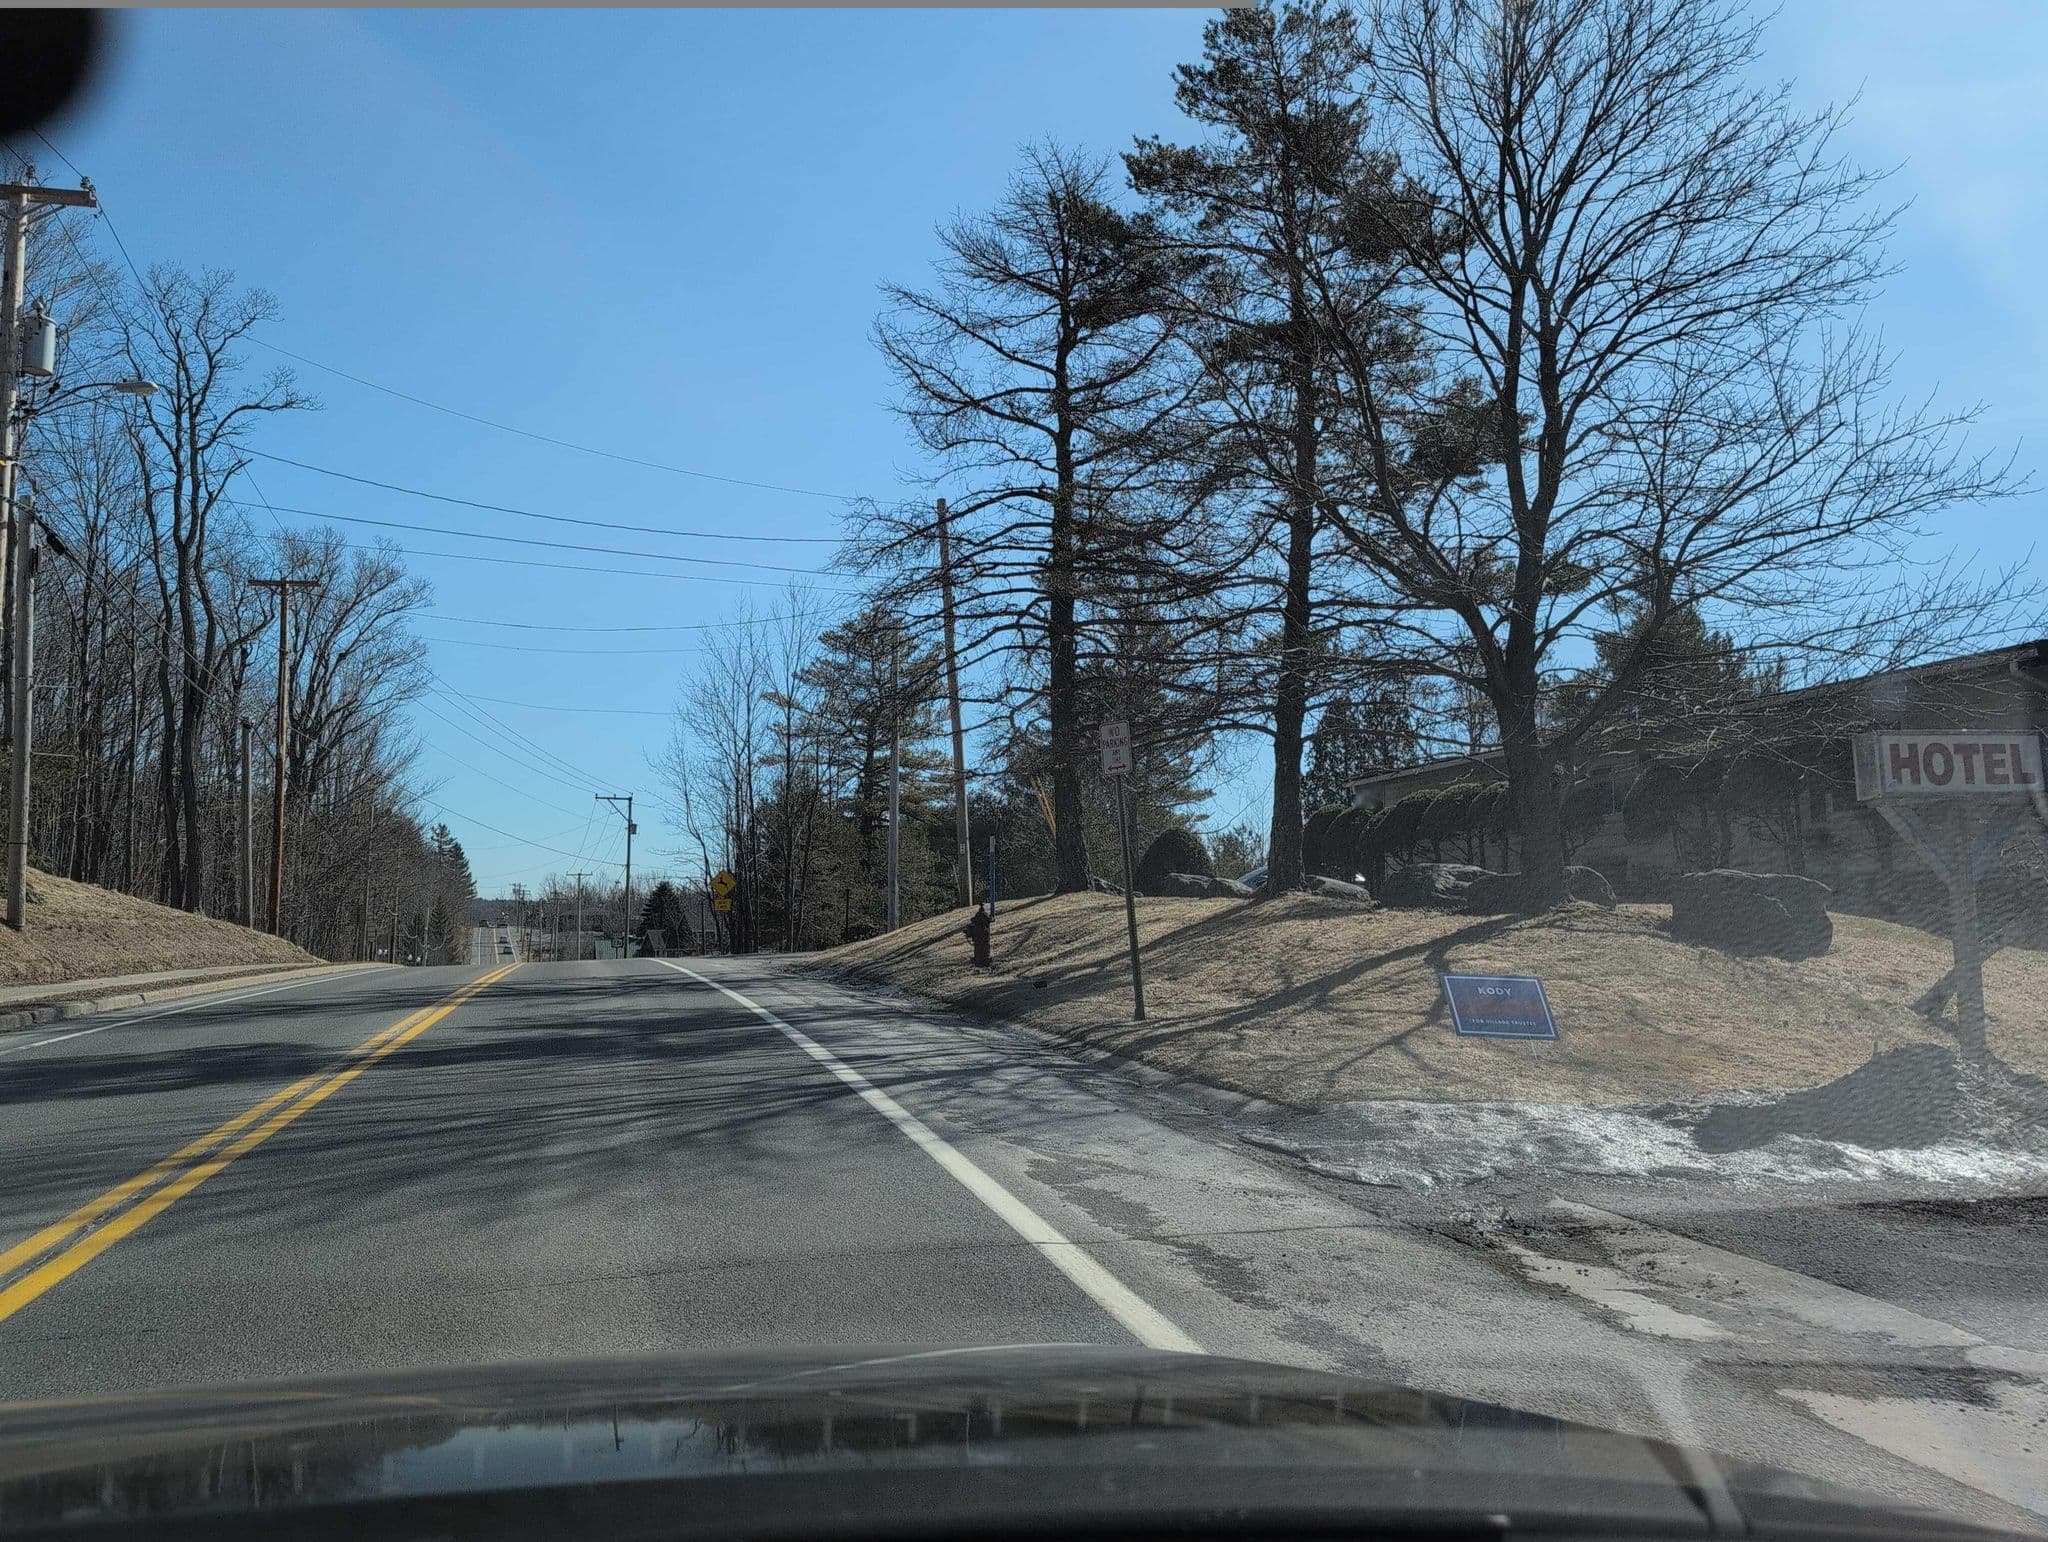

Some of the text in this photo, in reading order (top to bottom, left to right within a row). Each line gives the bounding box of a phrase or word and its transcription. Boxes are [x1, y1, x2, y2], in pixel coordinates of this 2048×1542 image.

[1102, 737, 1129, 749] PARKING
[1889, 743, 2035, 786] HOTEL
[1477, 986, 1512, 996] KODY
